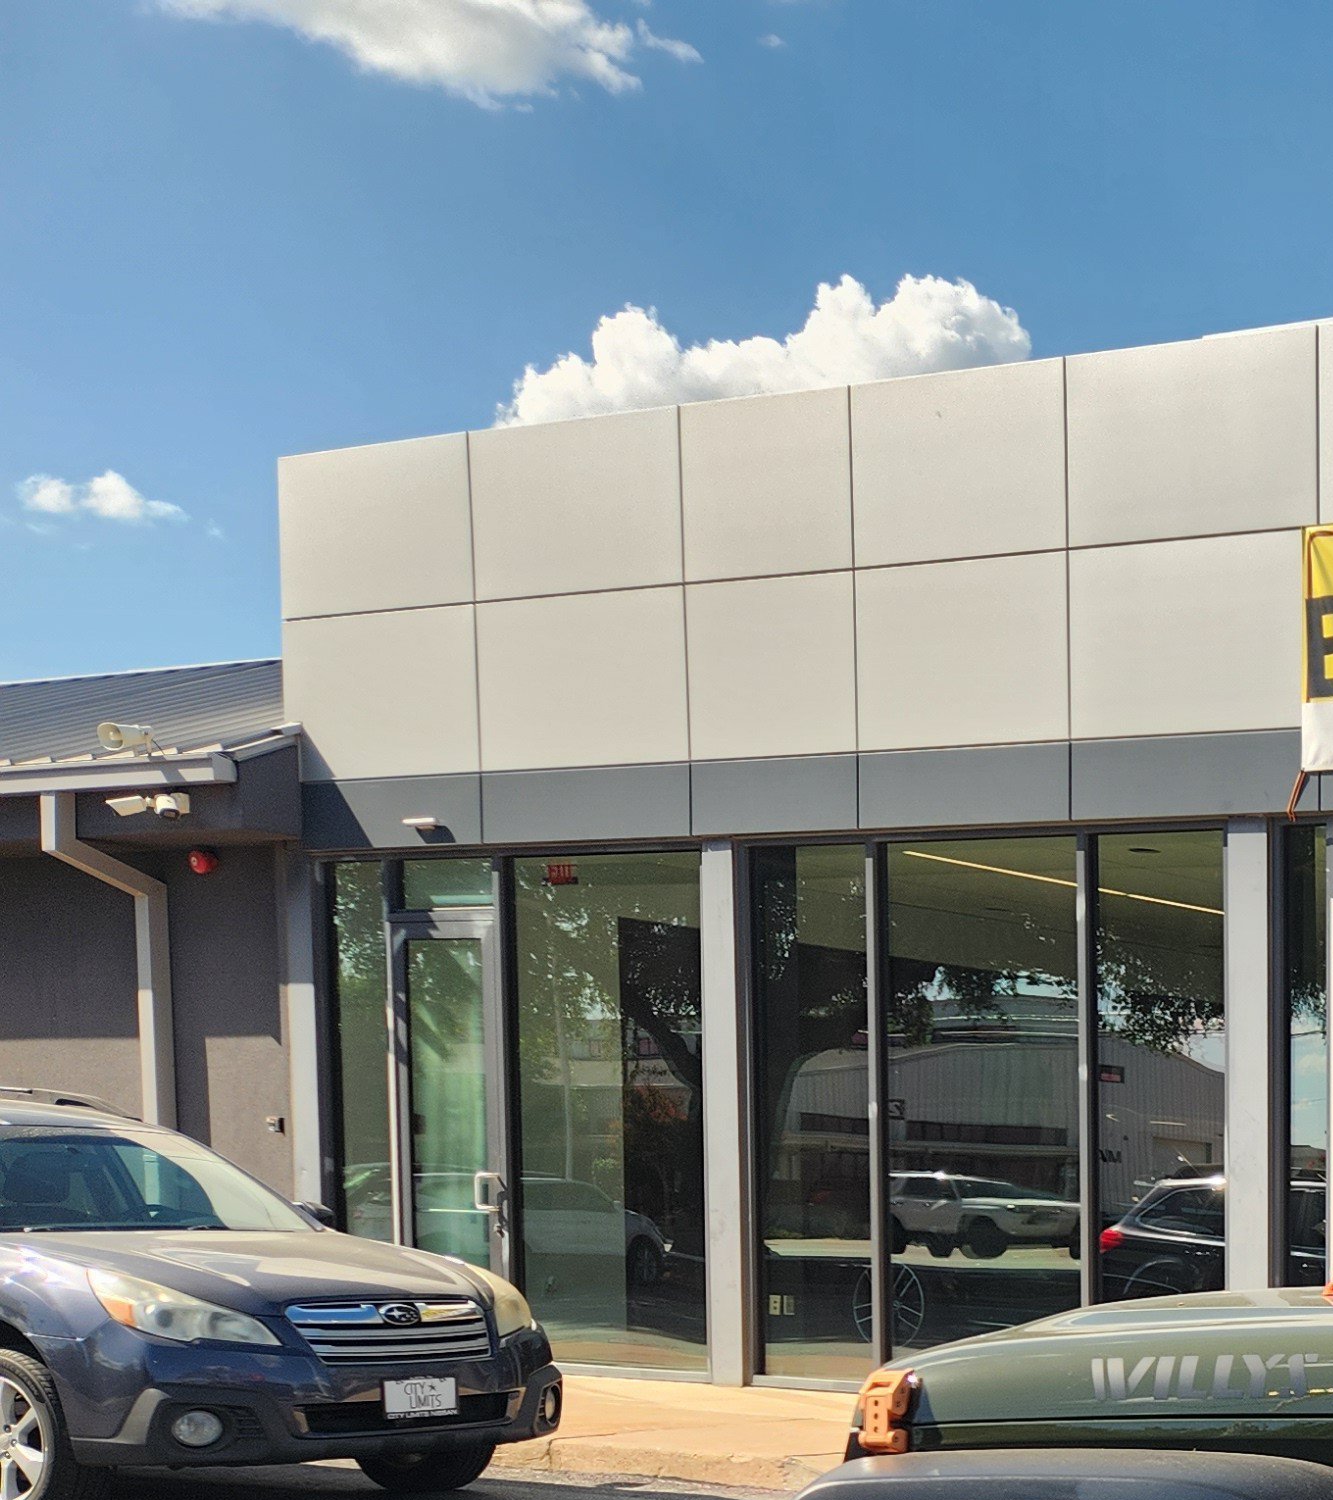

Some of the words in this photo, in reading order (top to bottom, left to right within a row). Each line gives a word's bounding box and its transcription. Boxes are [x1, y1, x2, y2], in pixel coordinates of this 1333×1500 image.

[404, 1382, 425, 1396] CITY
[409, 1394, 442, 1409] LIMITS
[387, 1412, 405, 1420] CITY
